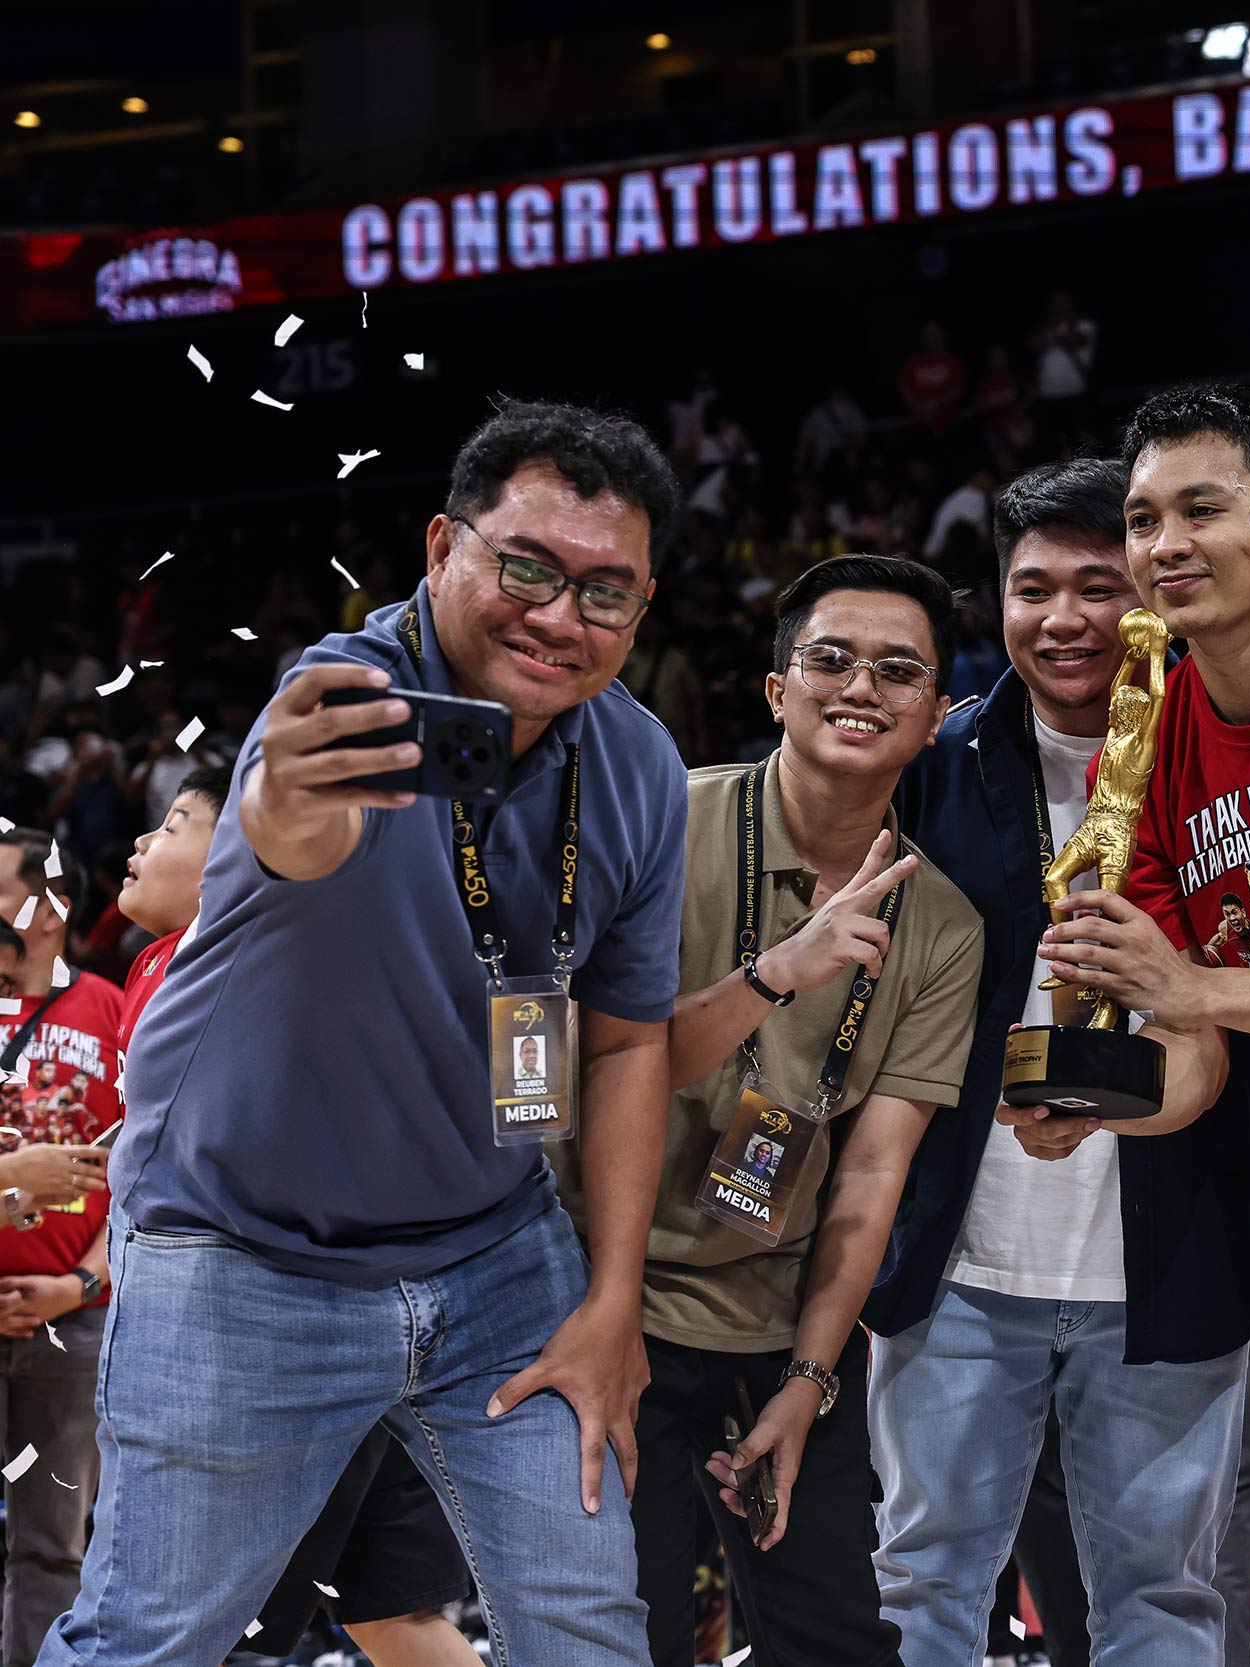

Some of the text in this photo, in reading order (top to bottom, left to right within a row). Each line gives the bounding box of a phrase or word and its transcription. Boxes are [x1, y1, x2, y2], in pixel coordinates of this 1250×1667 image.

[342, 107, 1142, 288] CONGRATULATIONS,
[745, 770, 757, 818] ASSOCIATION
[746, 878, 756, 928] PHILIPPINE
[40, 1022, 101, 1058] TAPANG
[513, 1086, 548, 1097] TERRADO
[516, 1079, 545, 1088] REUBEN
[505, 1103, 558, 1123] MEDIA
[729, 1173, 772, 1198] MAGALLON
[735, 1168, 771, 1190] REYNALD
[715, 1184, 772, 1223] MEDIA
